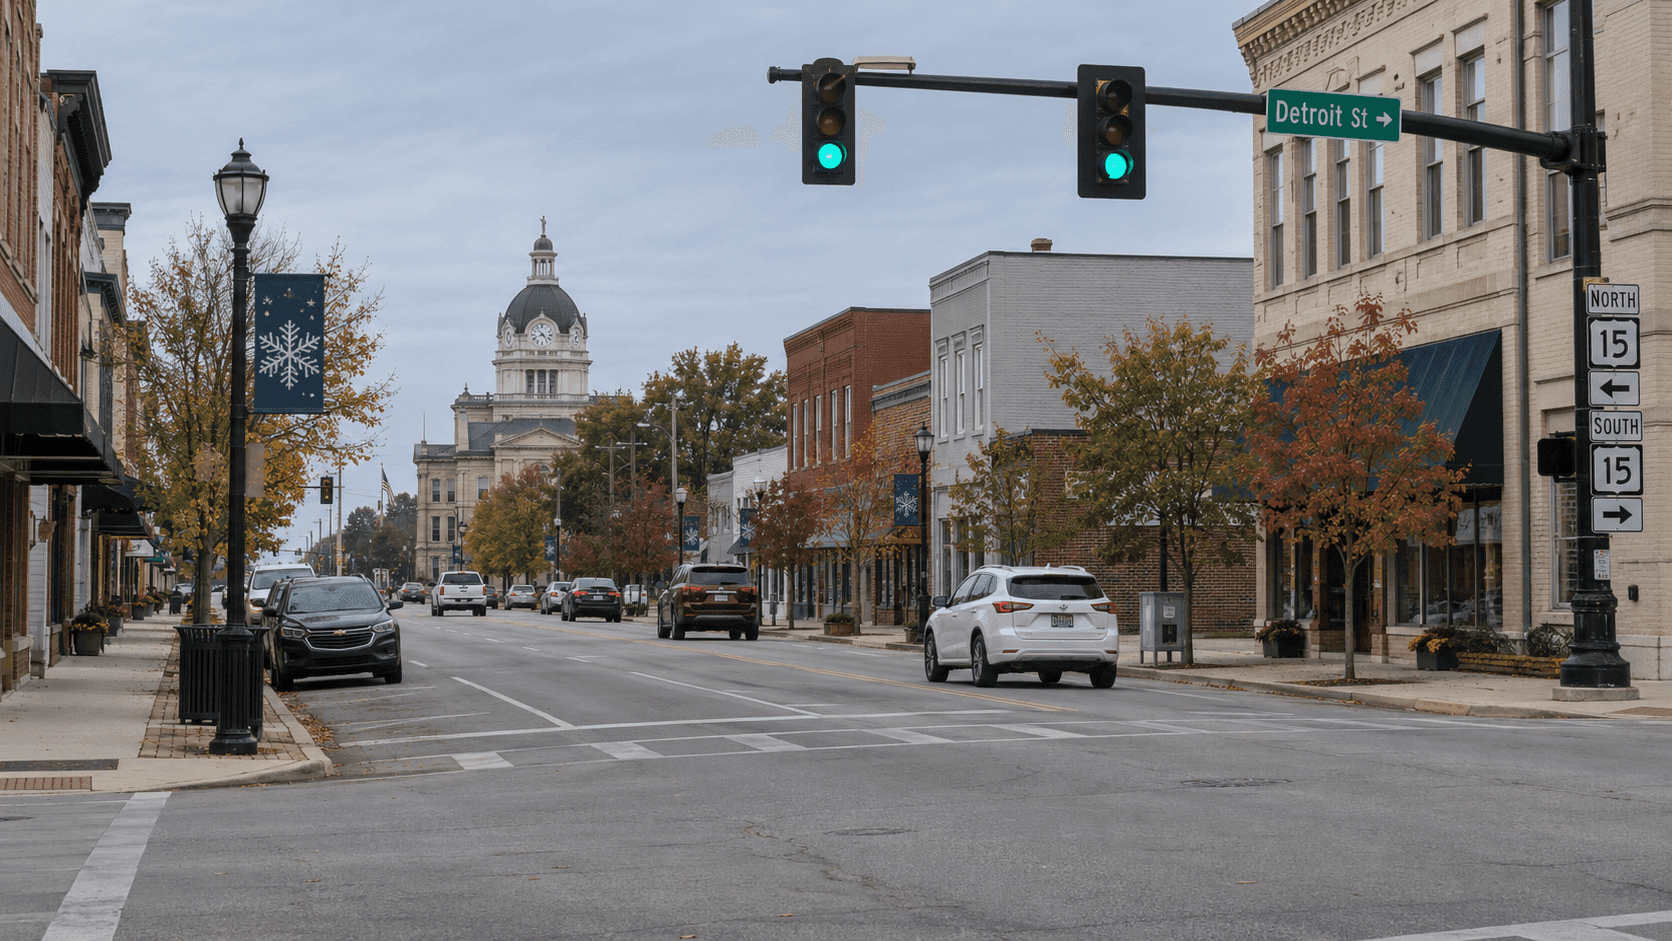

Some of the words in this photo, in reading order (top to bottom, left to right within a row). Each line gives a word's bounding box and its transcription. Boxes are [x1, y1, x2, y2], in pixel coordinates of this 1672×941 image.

[1275, 99, 1343, 127] Detroit
[1351, 106, 1369, 129] St
[1590, 289, 1636, 309] NORTH
[1600, 329, 1629, 359] 15
[1593, 416, 1639, 435] SOUTH
[1603, 456, 1632, 486] 15
